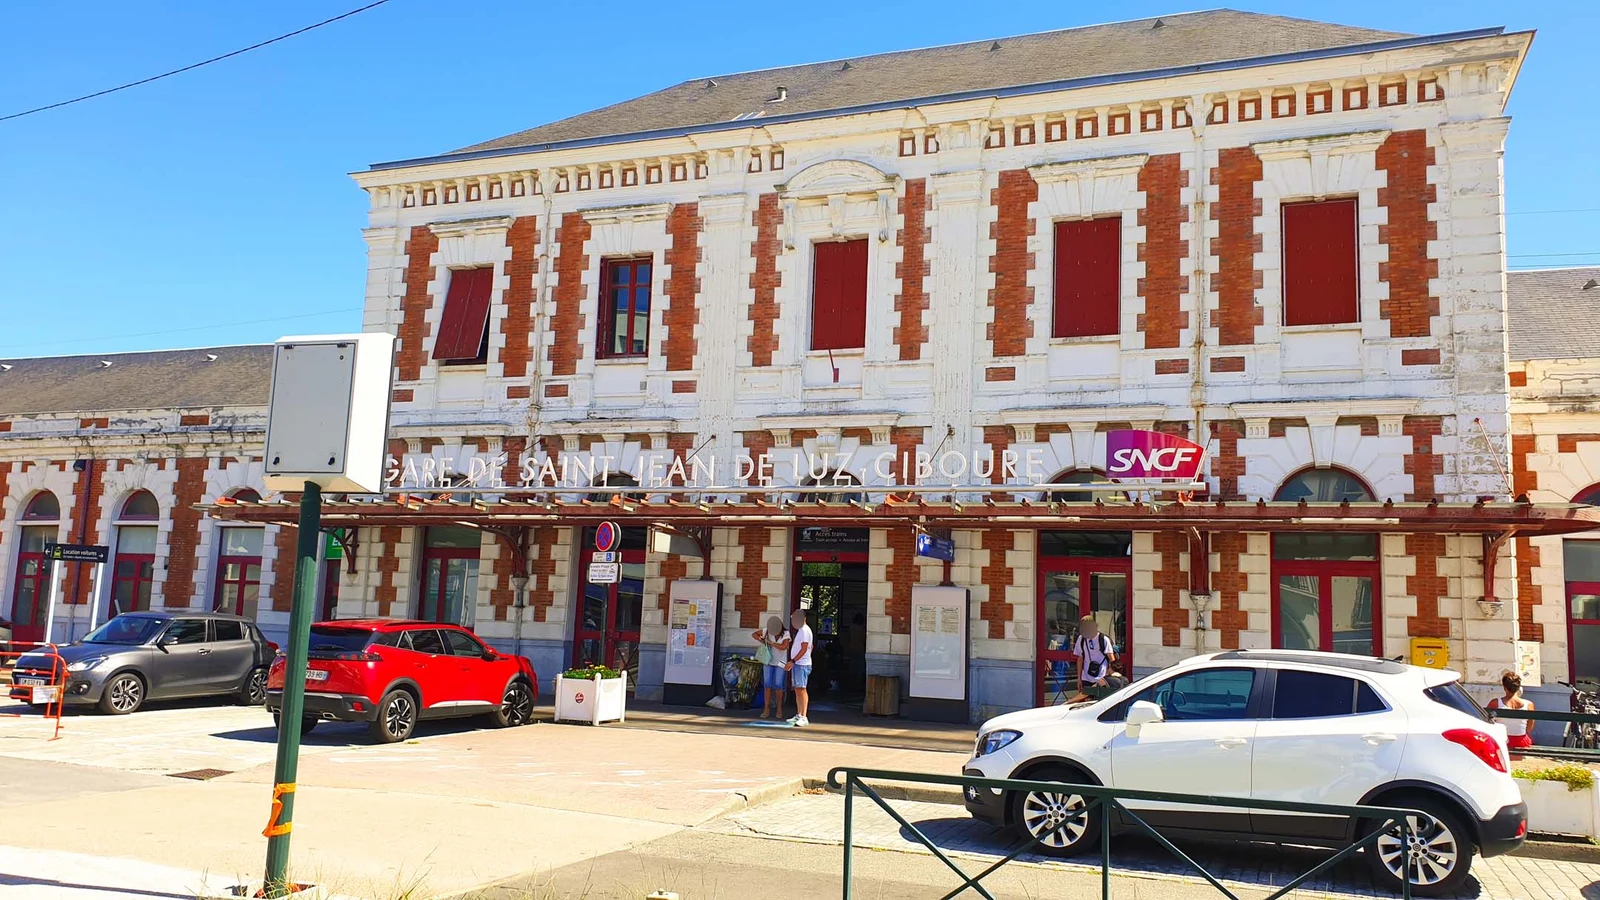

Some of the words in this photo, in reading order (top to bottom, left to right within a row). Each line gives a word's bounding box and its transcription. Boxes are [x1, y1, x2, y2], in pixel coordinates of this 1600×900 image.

[384, 457, 453, 482] GARE
[468, 456, 504, 482] DE
[519, 455, 614, 482] SAINT
[632, 454, 714, 482] JEAN
[734, 453, 773, 480] DE
[1109, 447, 1196, 472] SNCF
